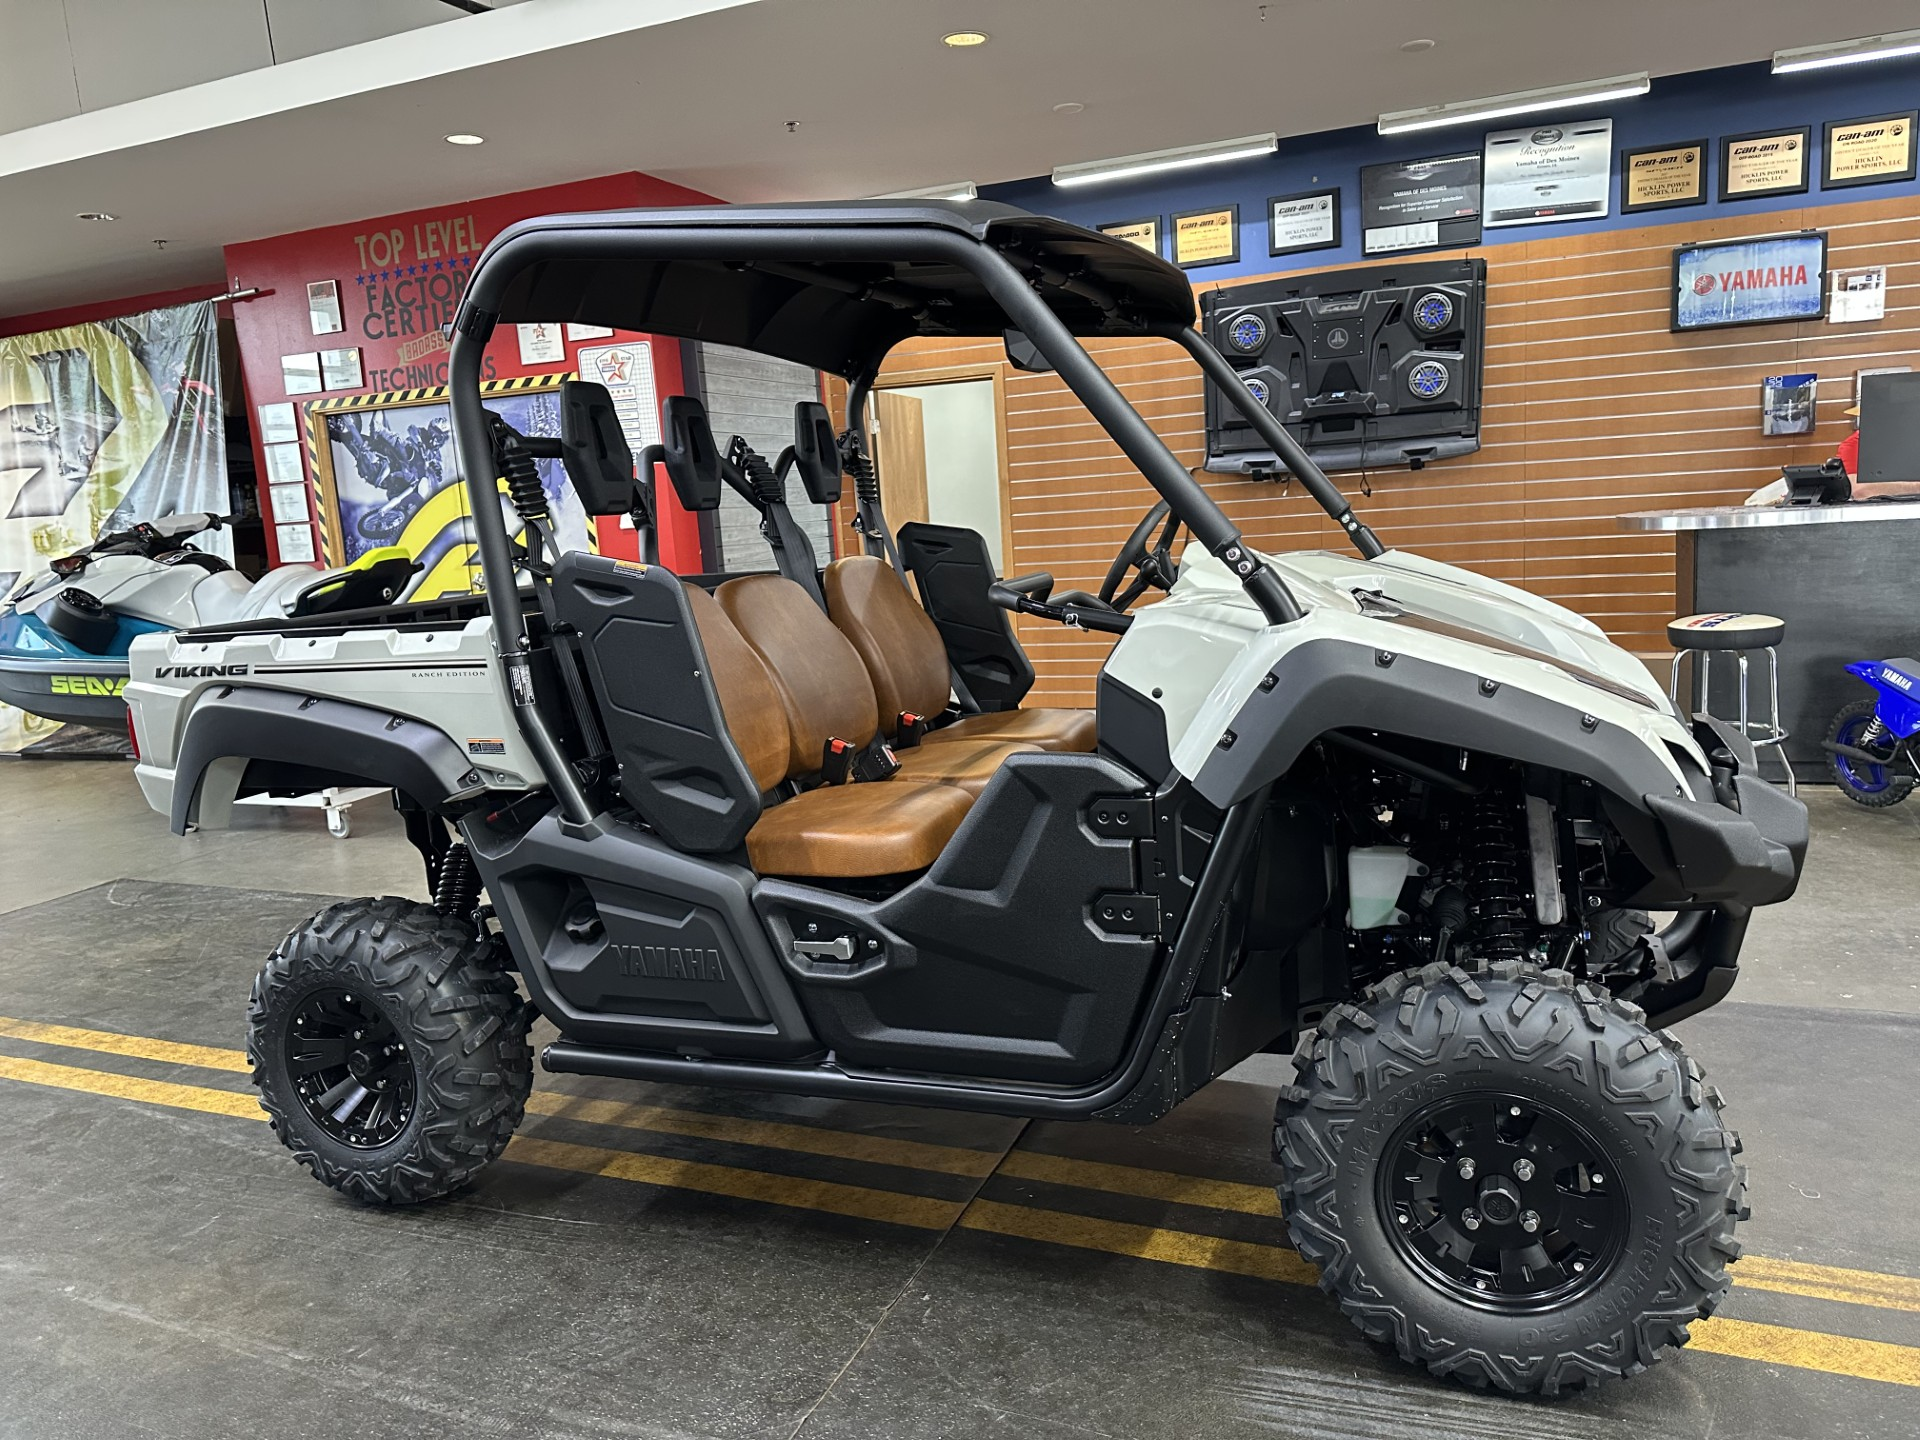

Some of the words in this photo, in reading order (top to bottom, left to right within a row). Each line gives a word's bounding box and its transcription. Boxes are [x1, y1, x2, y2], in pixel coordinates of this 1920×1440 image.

[1837, 129, 1884, 141] can-am
[1520, 144, 1575, 156] Recognition
[1734, 143, 1779, 155] can-am
[1634, 156, 1678, 167] can-am
[1855, 155, 1883, 164] HICKLIN
[1836, 164, 1860, 172] POWER
[1637, 184, 1665, 192] HICKLIN
[1666, 181, 1691, 189] POWER
[1279, 203, 1314, 214] can-am
[1180, 219, 1214, 230] can-am
[354, 228, 405, 270] TOP
[413, 214, 483, 260] LEVEL
[1719, 264, 1808, 293] YAMAHA
[366, 267, 473, 313] FACTOR
[404, 333, 444, 360] BADASS
[154, 664, 249, 679] VIKING
[411, 671, 444, 679] RANCH
[446, 670, 487, 678] EDITION
[1881, 667, 1912, 691] YAMAHA
[611, 944, 725, 981] YAMAHA
